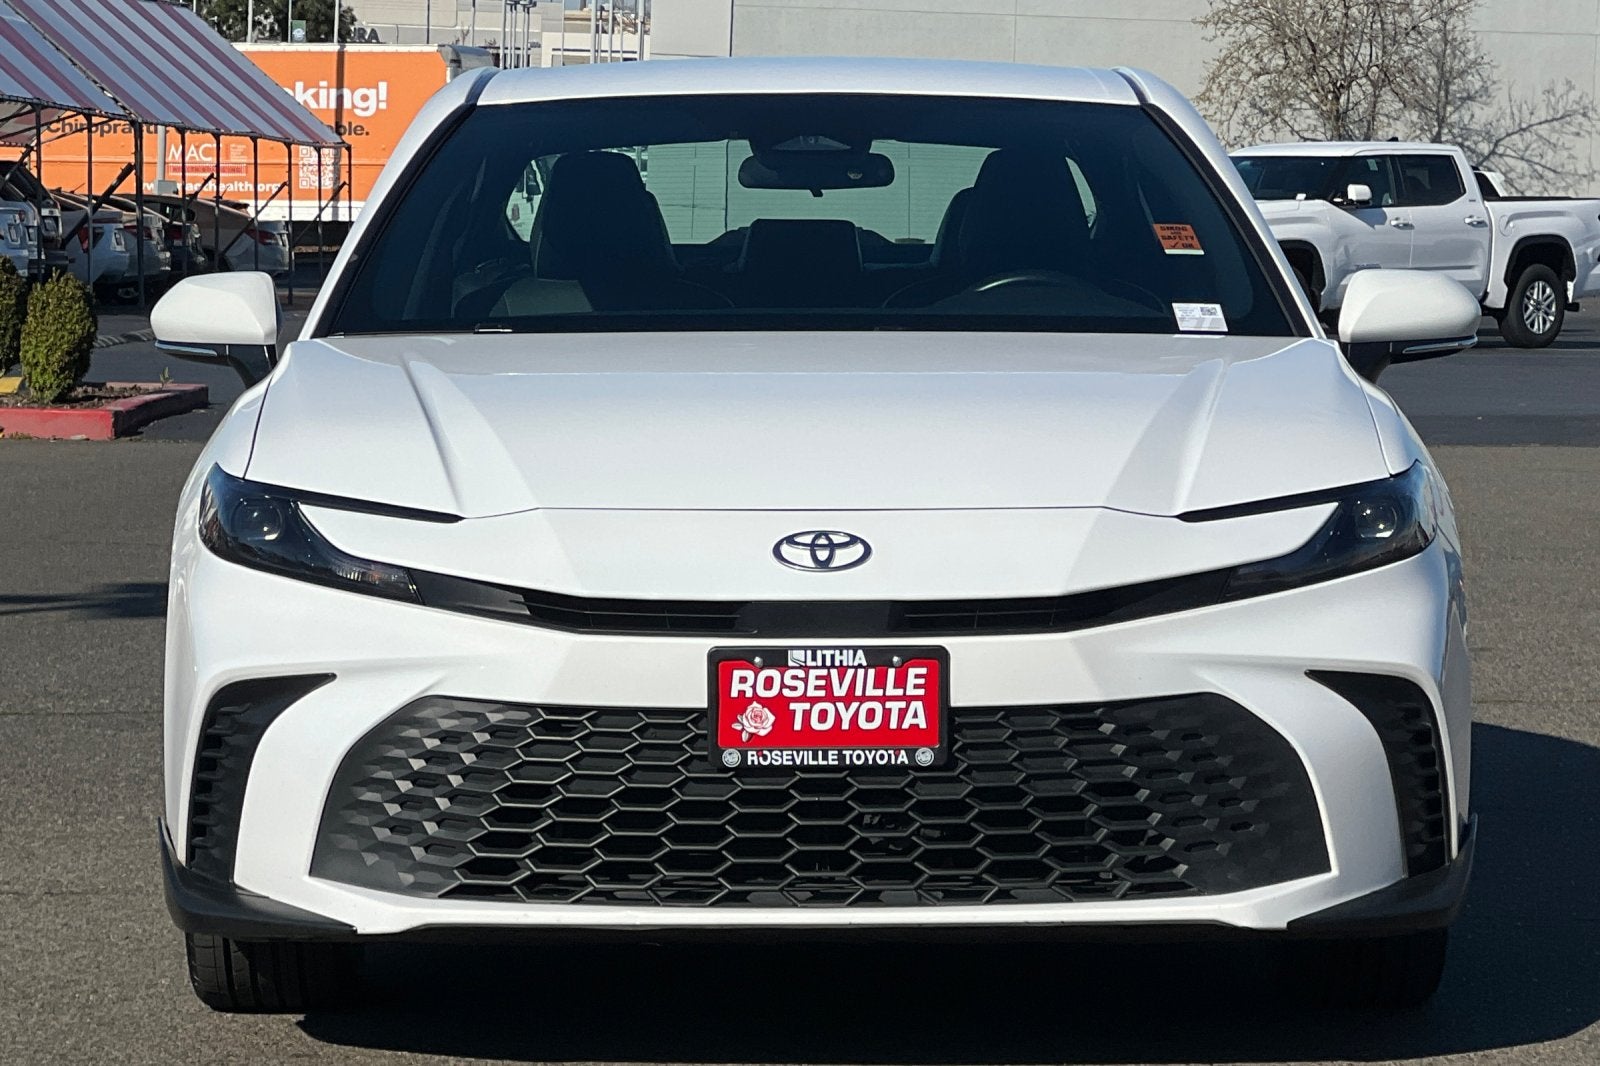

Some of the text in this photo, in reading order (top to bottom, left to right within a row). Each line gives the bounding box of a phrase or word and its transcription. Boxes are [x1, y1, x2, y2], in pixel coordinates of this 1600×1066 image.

[283, 81, 388, 117] king!
[806, 649, 867, 667] LITHIA
[730, 667, 928, 698] ROSEVILLE
[789, 700, 927, 731] TOYOTA
[747, 750, 909, 766] ROSEVILLE TOYOTA
